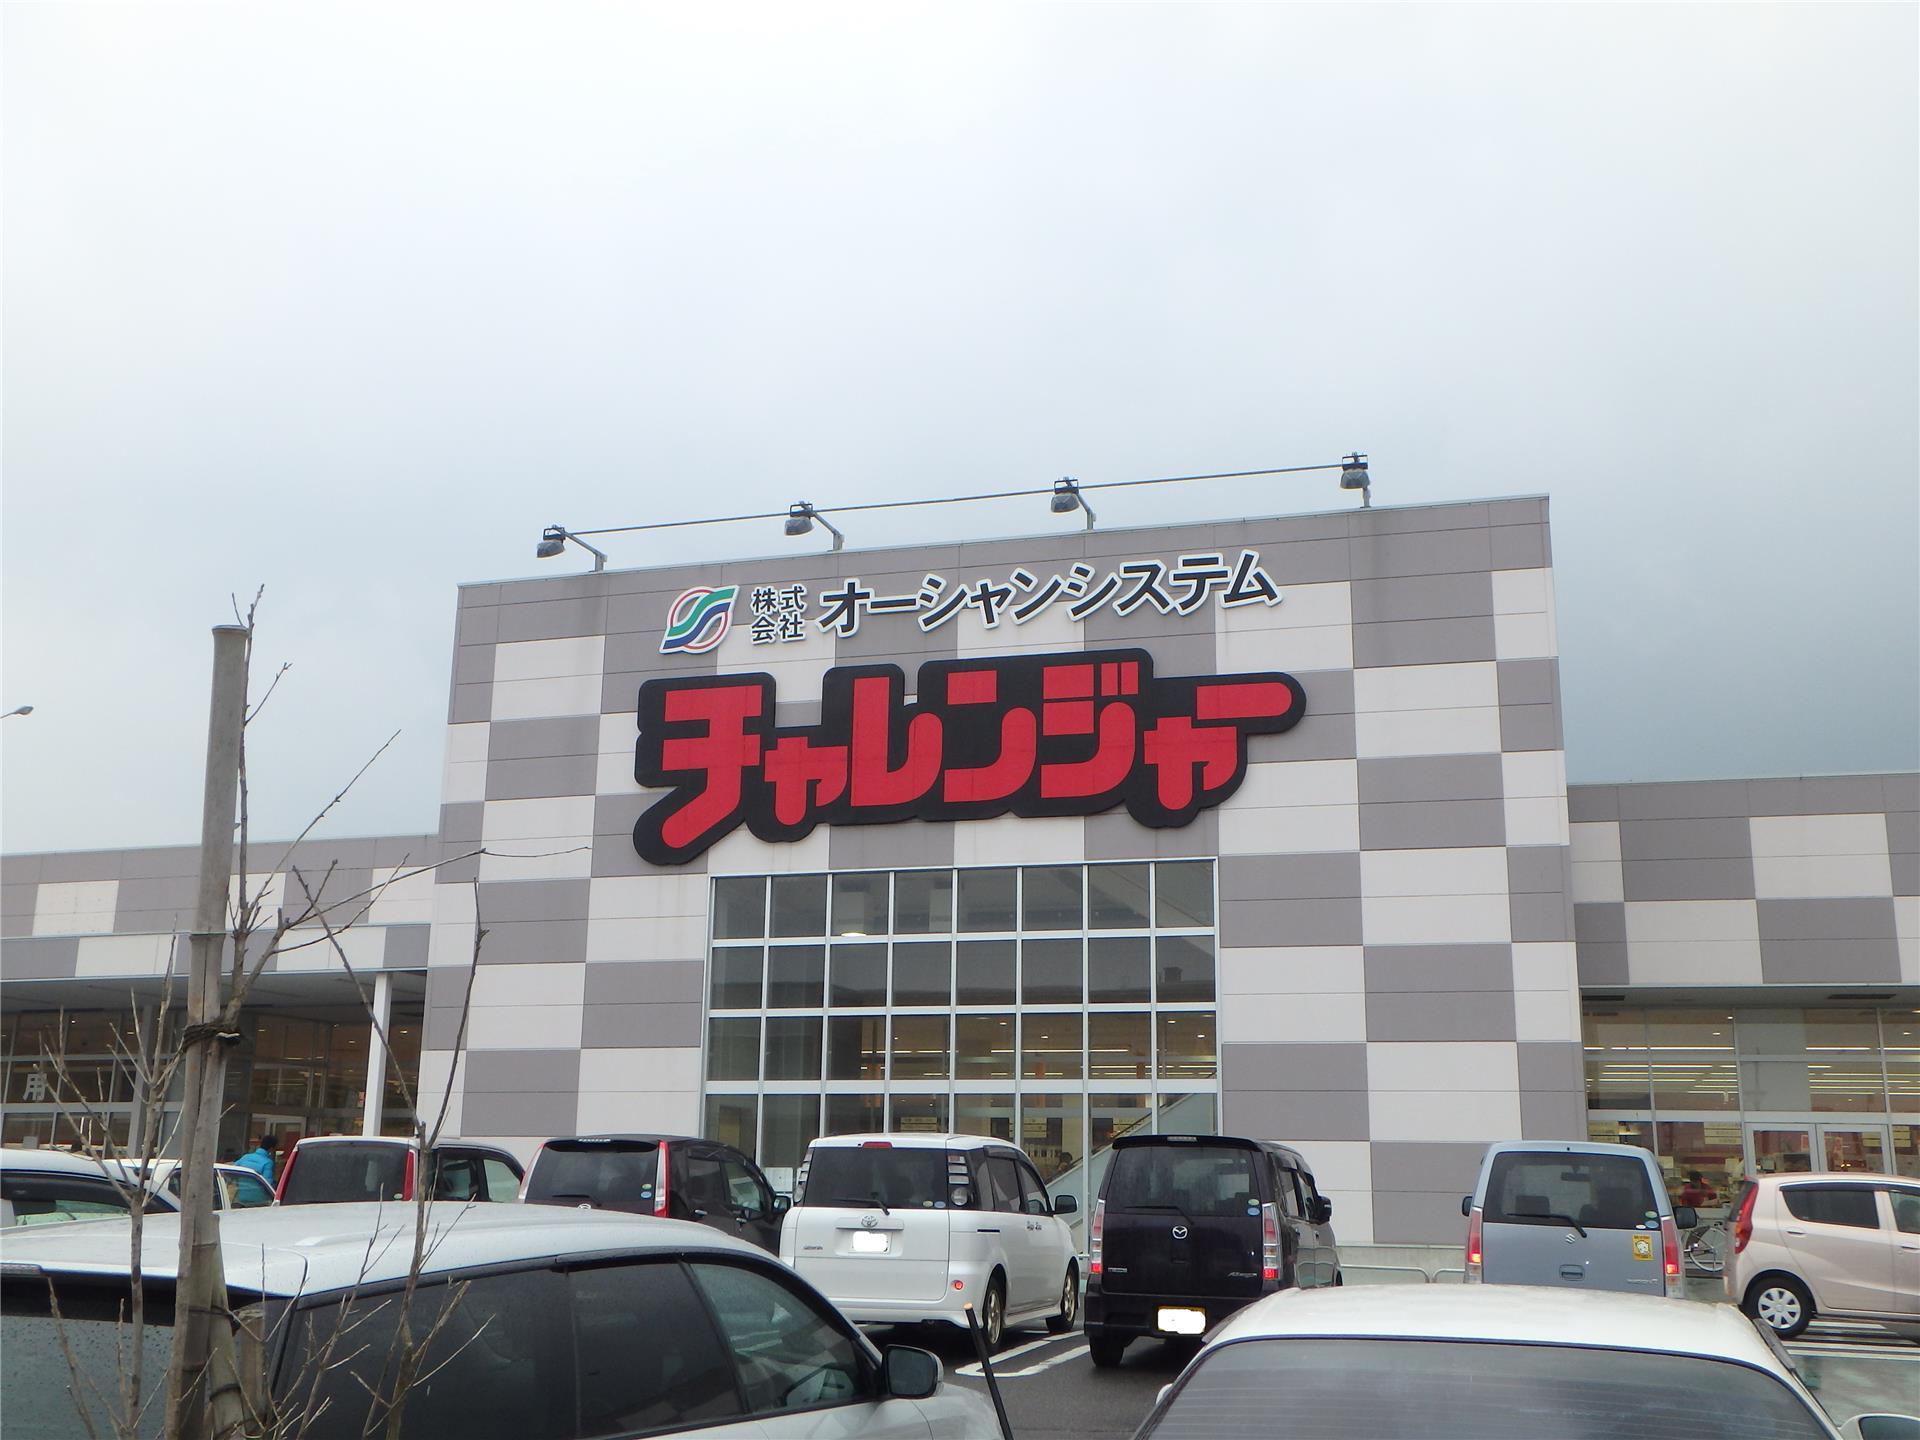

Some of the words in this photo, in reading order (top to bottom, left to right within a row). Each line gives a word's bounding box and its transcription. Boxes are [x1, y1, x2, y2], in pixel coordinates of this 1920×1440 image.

[817, 551, 1280, 635] オーシャンシステム
[658, 660, 1294, 850] チャレンジャー
